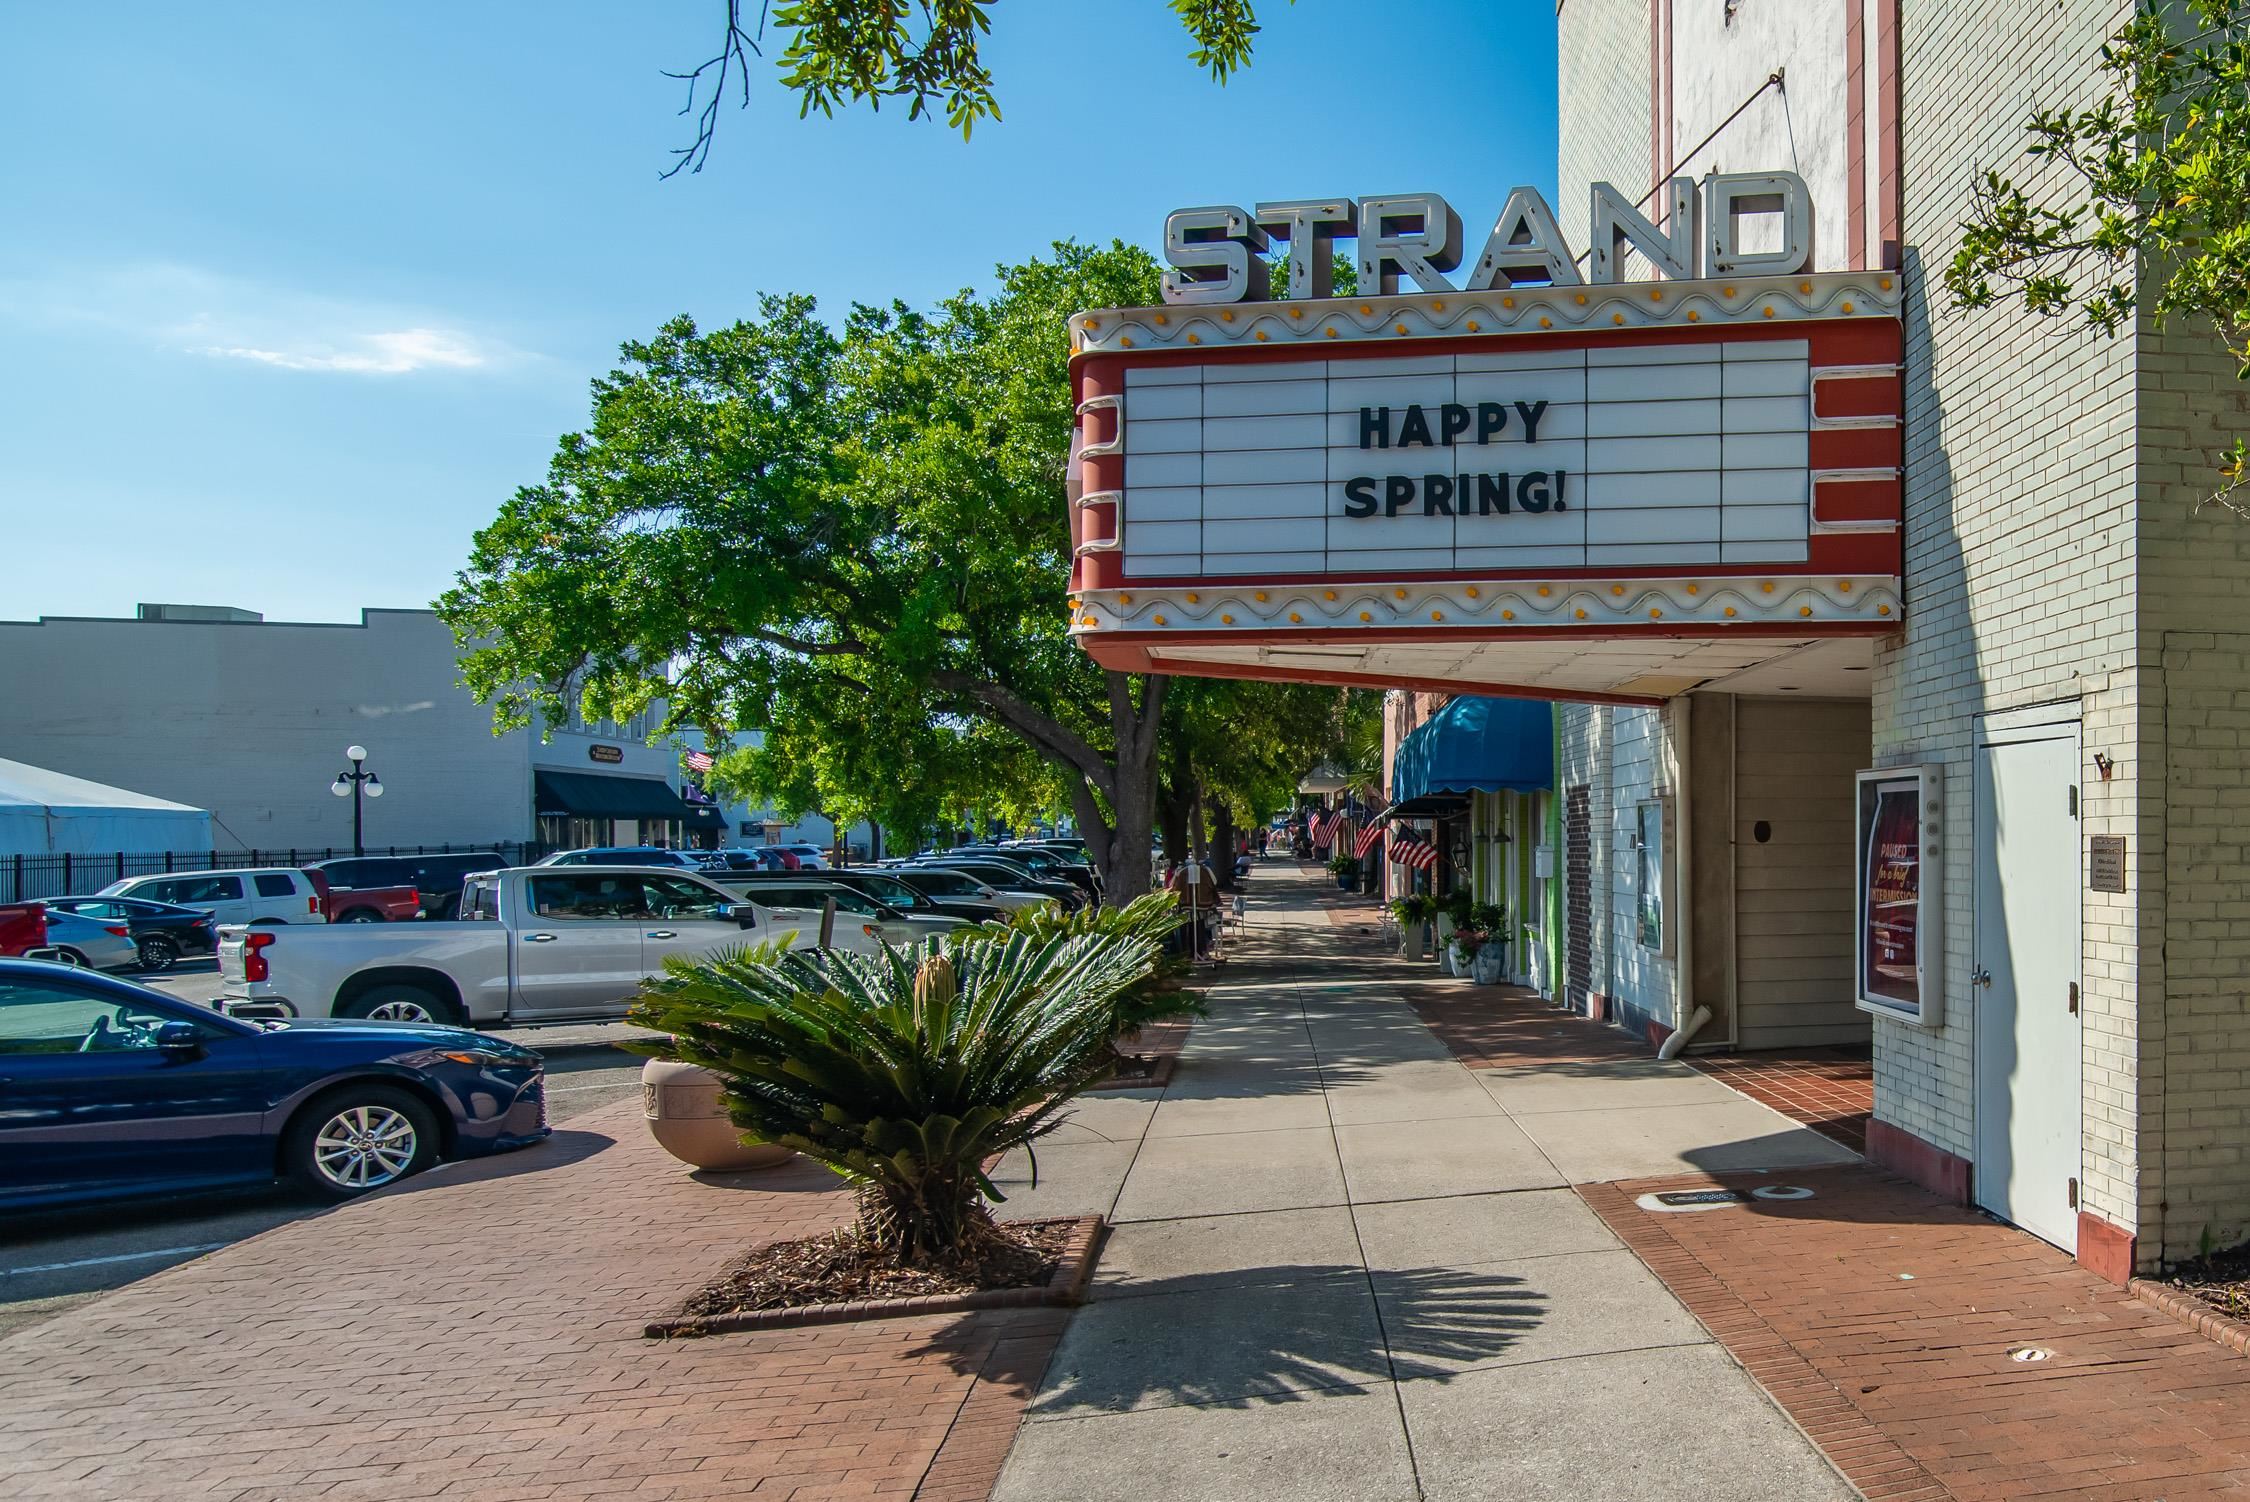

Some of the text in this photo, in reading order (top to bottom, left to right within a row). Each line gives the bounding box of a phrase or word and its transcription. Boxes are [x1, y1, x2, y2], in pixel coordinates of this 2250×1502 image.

[1160, 170, 1811, 304] STRAND
[1360, 400, 1549, 449] HAPPY
[1345, 470, 1567, 518] SPRING!
[1880, 843, 1908, 859] PAUSED
